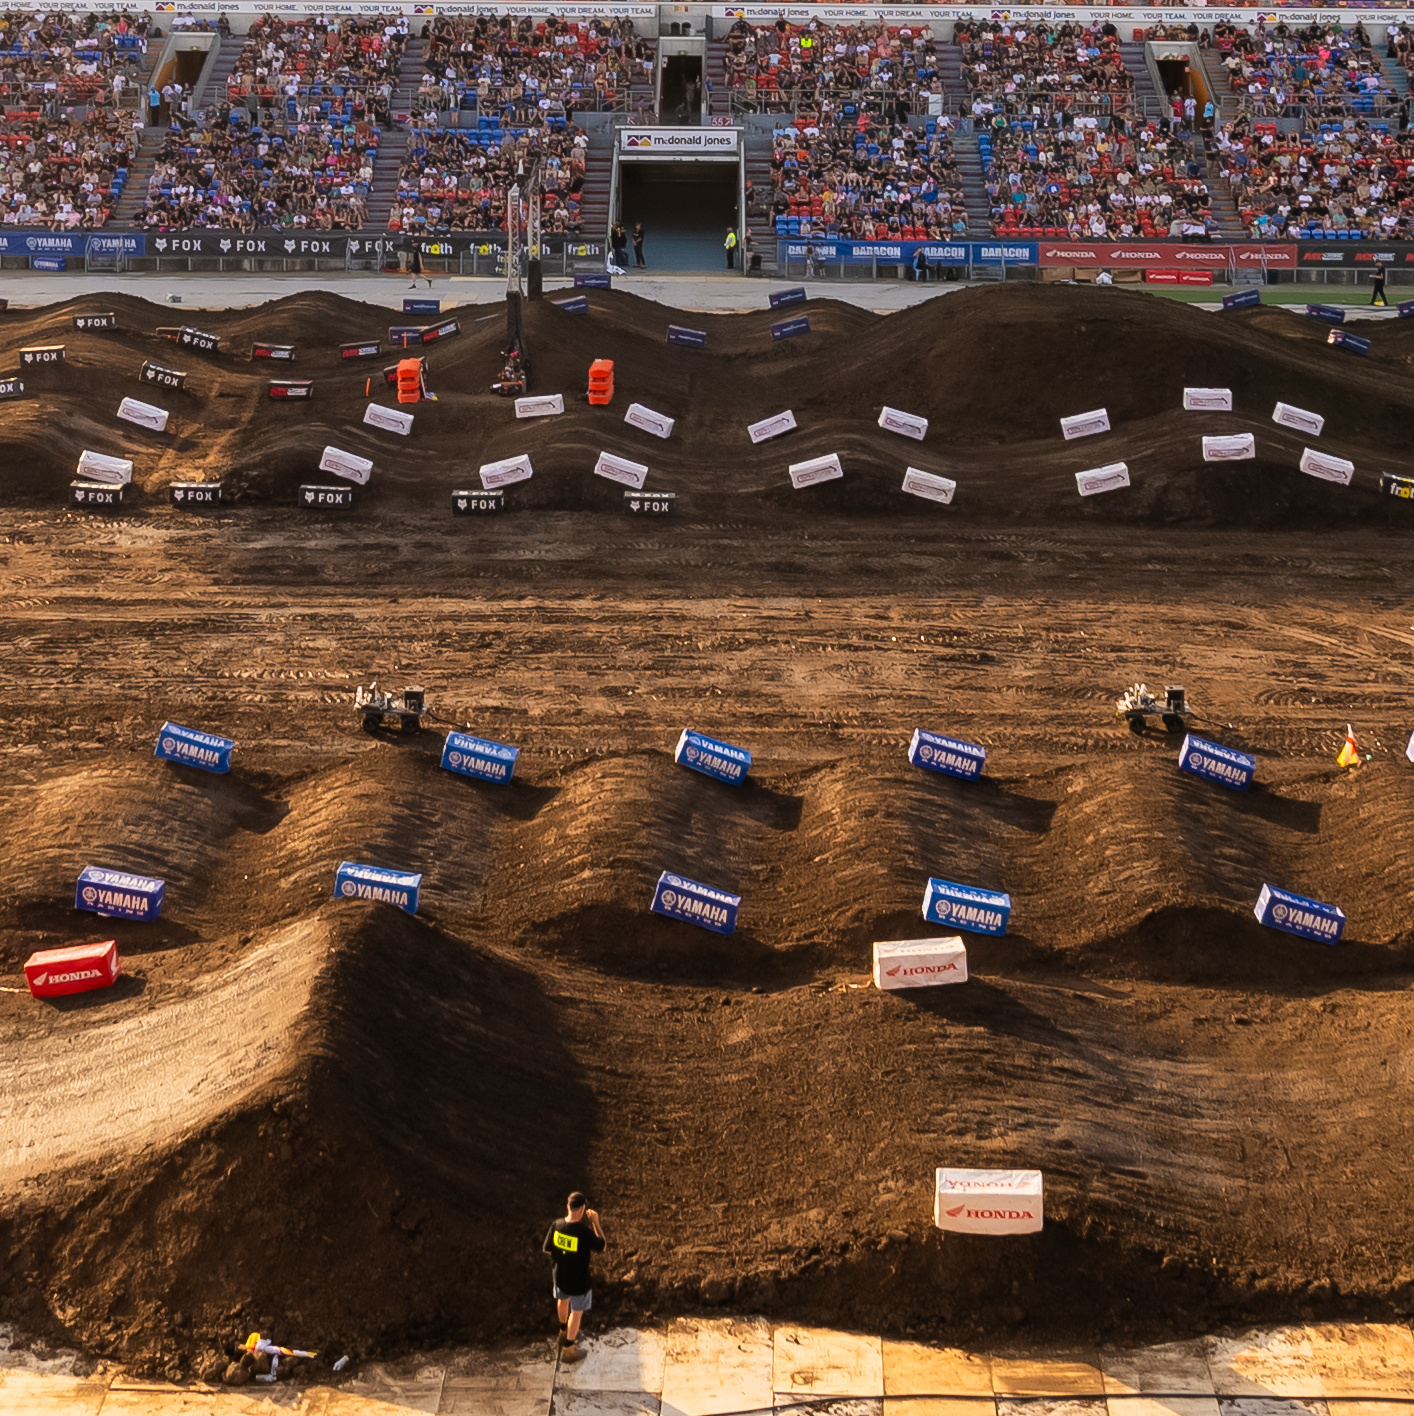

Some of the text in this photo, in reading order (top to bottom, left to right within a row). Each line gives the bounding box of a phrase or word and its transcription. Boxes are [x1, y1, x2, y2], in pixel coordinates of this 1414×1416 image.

[506, 6, 525, 14] YOUR
[555, 6, 575, 14] YOUR
[609, 7, 628, 15] YOUR
[711, 117, 724, 126] 55
[654, 134, 732, 146] mcdonald jones
[36, 237, 72, 248] YAMAHA
[172, 239, 201, 251] FOX
[237, 240, 266, 252] FOX
[301, 241, 330, 252] FOX
[365, 241, 394, 252] FOX
[421, 243, 453, 254] froth
[568, 244, 599, 255] froth
[852, 247, 900, 258] DARACON
[921, 247, 965, 259] ARACON
[981, 248, 1029, 259] DARACON
[1057, 251, 1096, 259] HONDA
[1121, 251, 1161, 259] HONDA
[1186, 252, 1225, 260] HONDA
[1250, 253, 1290, 261] HONDA
[87, 318, 107, 327] FOX
[192, 337, 213, 350] FOX
[36, 351, 57, 362] FOX
[158, 373, 179, 386] FOX
[89, 492, 113, 503] FOX
[188, 491, 213, 501] FOX
[318, 492, 343, 504] FOX
[471, 499, 496, 510] FOX
[644, 500, 669, 512] FOX
[175, 740, 220, 764] YAMAHA
[463, 755, 506, 776] YAMAHA
[698, 750, 741, 778] YAMAHA
[933, 748, 977, 773] YAMAHA
[1204, 758, 1246, 783] YAMAHA
[98, 889, 149, 911] YAMAHA
[357, 883, 408, 905] YAMAHA
[677, 896, 728, 923] YAMAHA
[952, 904, 1002, 927] YAMAHA
[1287, 909, 1338, 934] YAMAHA
[902, 962, 958, 977] HONDA
[48, 969, 103, 984] HONDA
[966, 1209, 1034, 1219] HONDA
[557, 1234, 572, 1249] CREW
